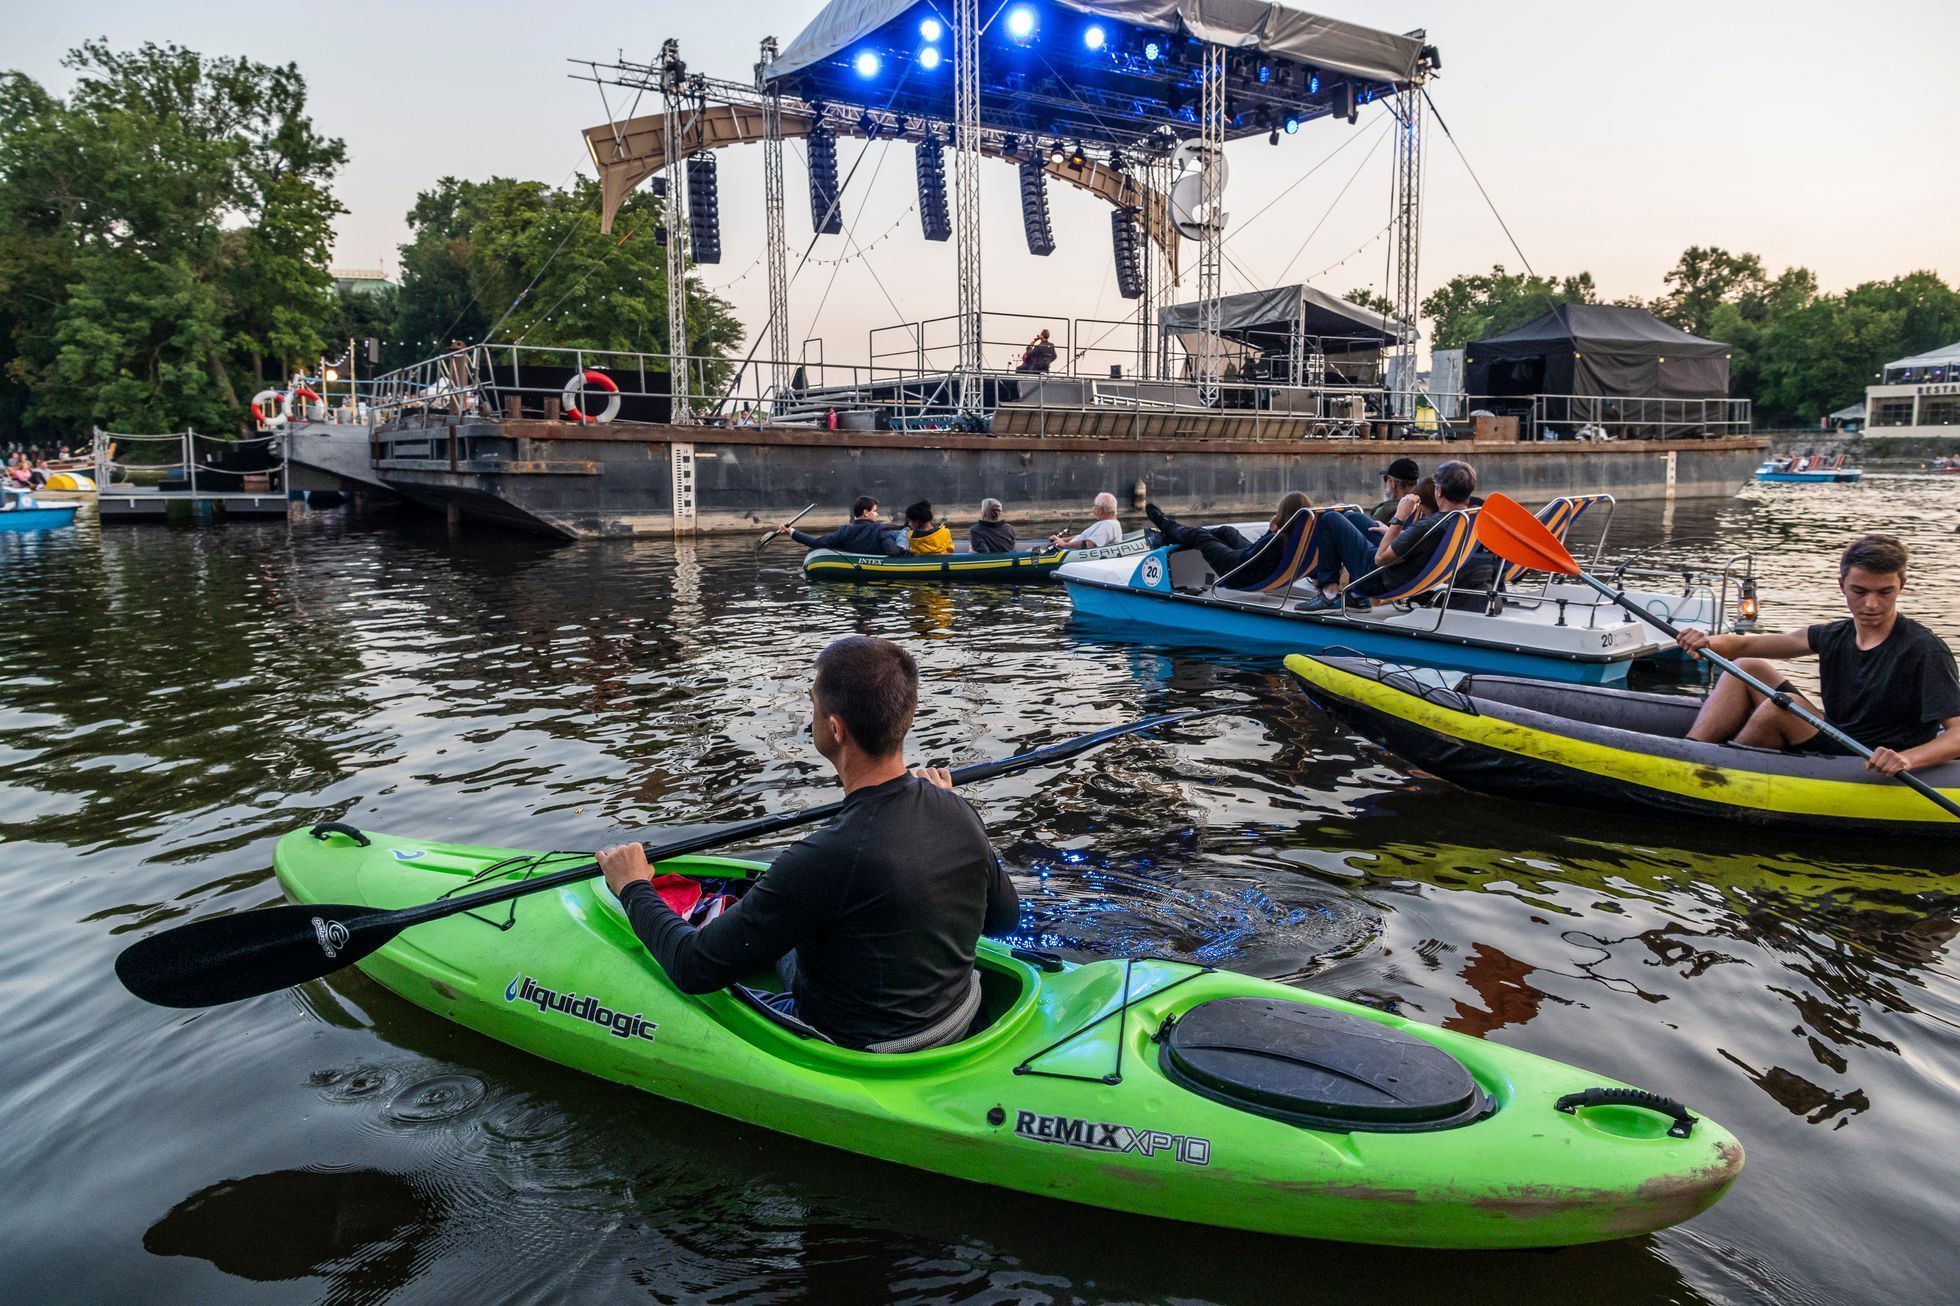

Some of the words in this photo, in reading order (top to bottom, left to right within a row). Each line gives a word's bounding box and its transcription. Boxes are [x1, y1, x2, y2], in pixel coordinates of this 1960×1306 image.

[1917, 385, 1960, 394] RESTA
[1079, 540, 1147, 559] SEAHAW
[858, 557, 883, 565] INTEX
[1601, 633, 1613, 648] 20
[518, 976, 658, 1041] liquidlogic
